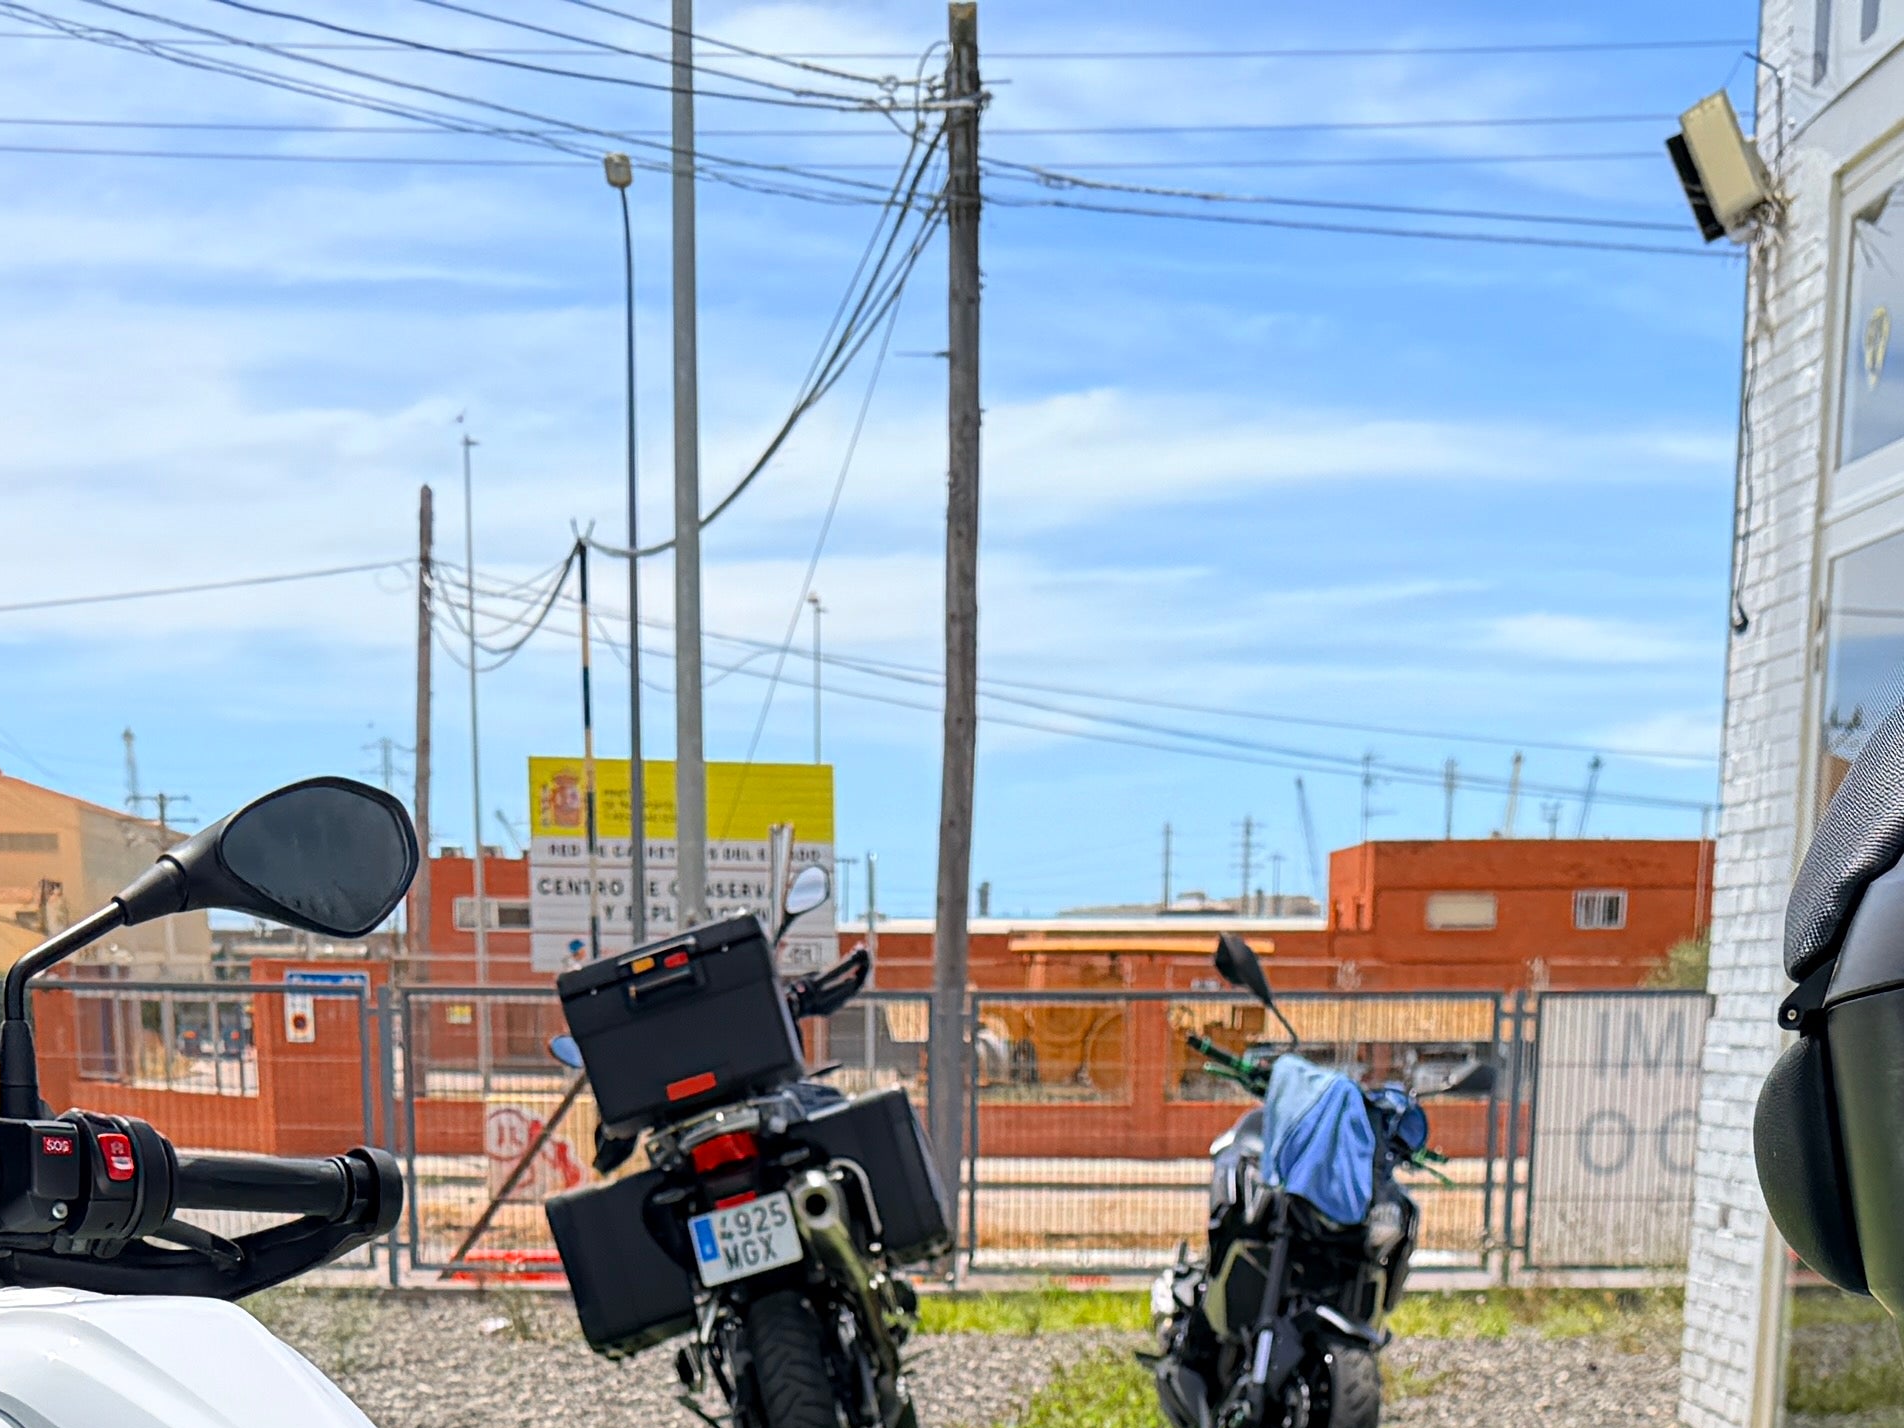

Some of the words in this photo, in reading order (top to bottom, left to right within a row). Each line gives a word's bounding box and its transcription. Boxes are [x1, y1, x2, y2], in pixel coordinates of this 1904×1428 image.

[45, 1137, 70, 1153] SOS
[719, 1200, 788, 1240] 4925
[724, 1233, 778, 1271] MGX
